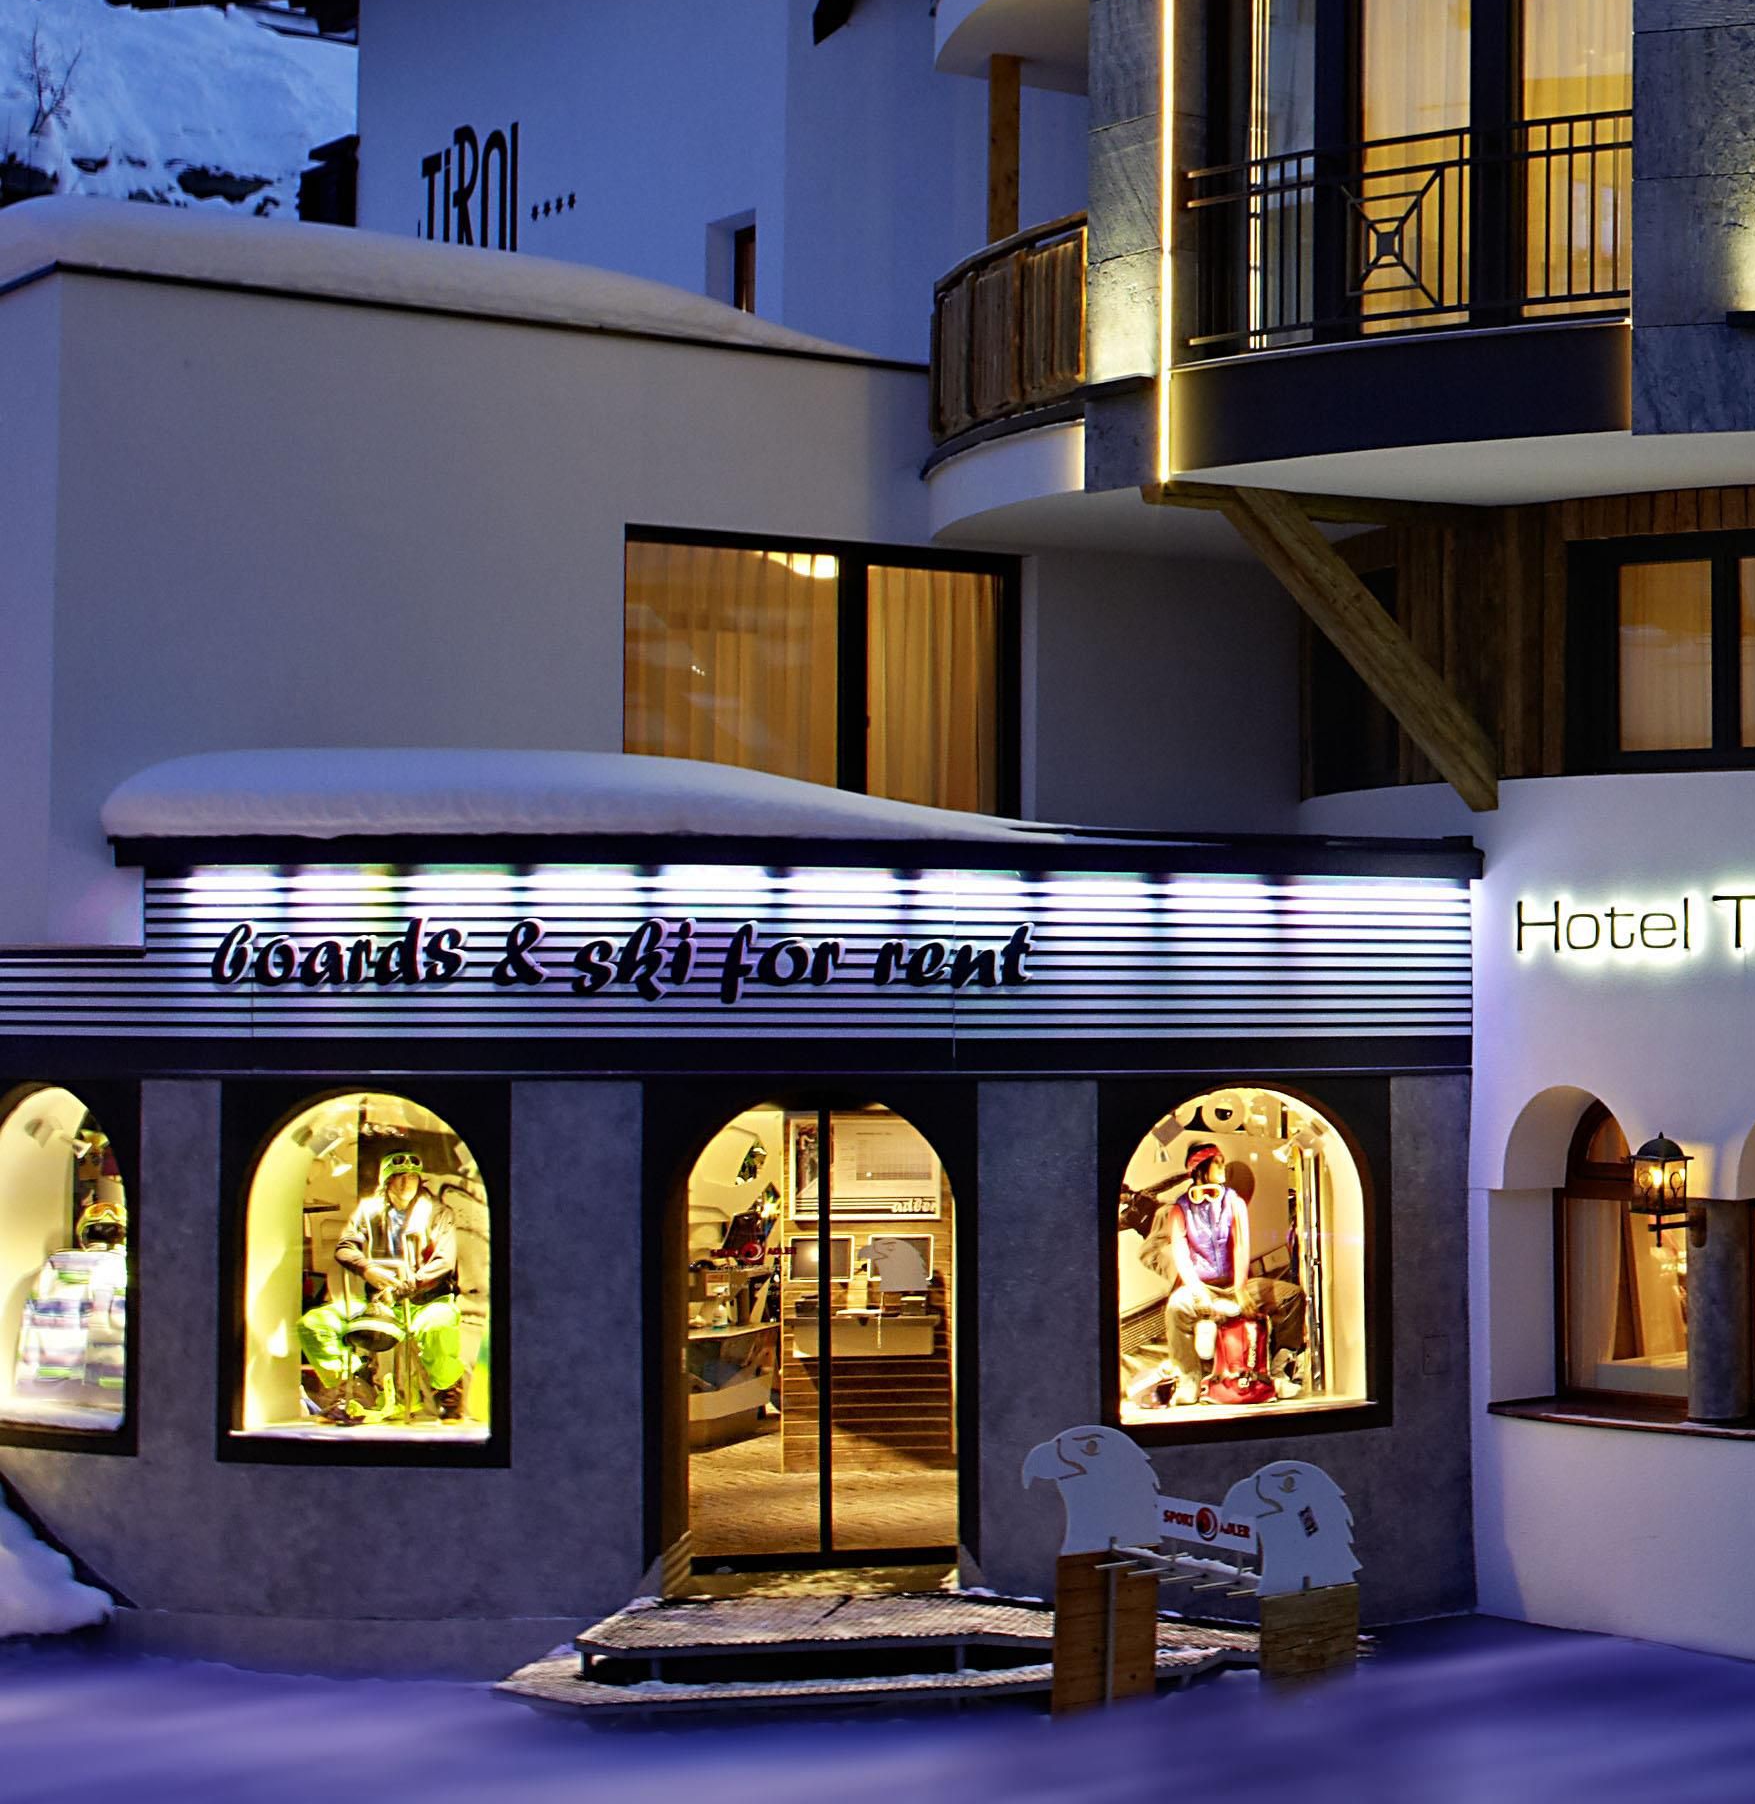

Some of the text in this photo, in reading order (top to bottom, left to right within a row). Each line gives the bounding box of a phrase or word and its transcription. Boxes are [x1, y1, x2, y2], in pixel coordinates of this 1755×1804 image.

[211, 917, 1036, 1004] boards & ski for rent
[1516, 897, 1690, 953] Hotel
